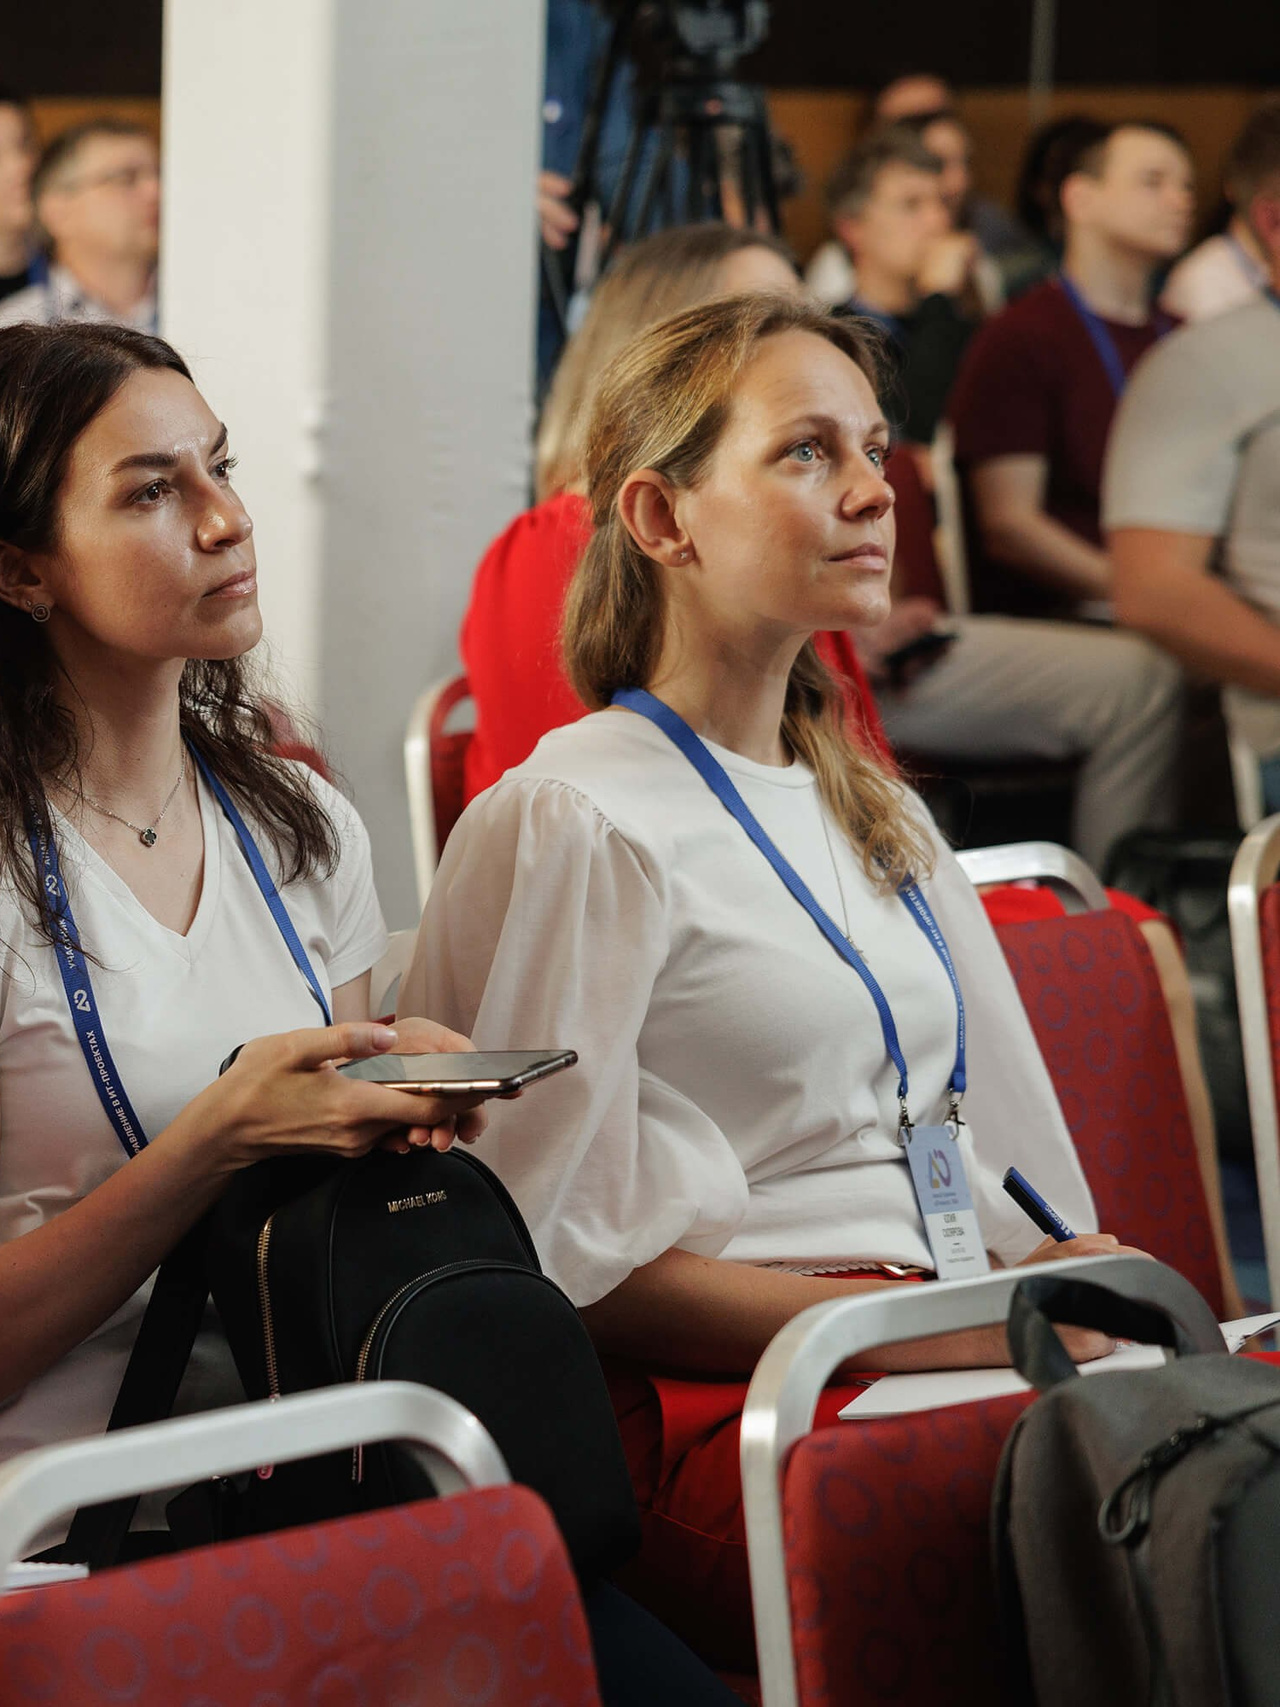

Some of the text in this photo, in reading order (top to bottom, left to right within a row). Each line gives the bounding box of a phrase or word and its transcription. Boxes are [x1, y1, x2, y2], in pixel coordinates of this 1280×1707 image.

[86, 1030, 118, 1100] ИТ-ПРОЕКТАХ
[111, 1099, 121, 1107] В
[387, 1190, 447, 1214] MICHAEL KORS
